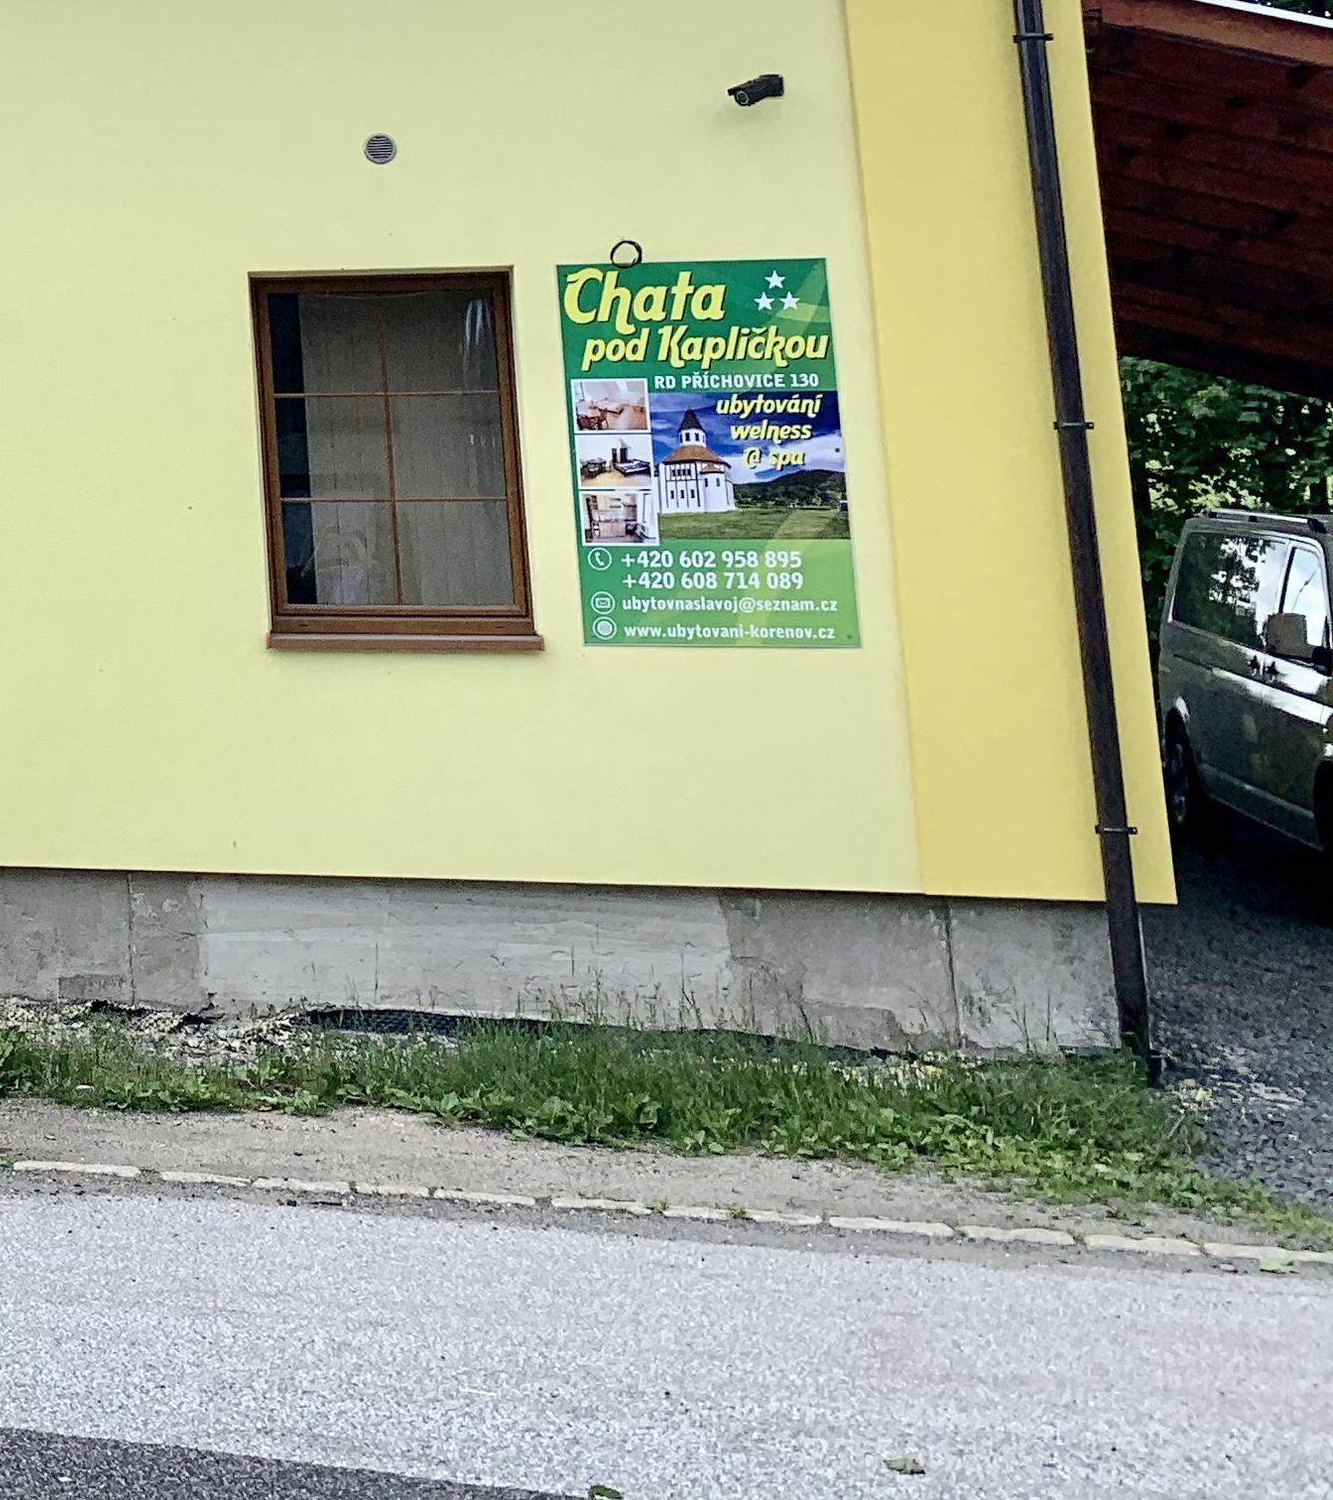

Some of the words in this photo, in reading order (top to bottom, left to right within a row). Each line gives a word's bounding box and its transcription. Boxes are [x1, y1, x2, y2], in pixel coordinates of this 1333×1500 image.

[563, 267, 726, 334] Chata
[581, 329, 648, 371] pod
[657, 325, 829, 369] Kapličkou
[654, 375, 676, 390] RD
[681, 372, 784, 389] PŘÍCHOVICE
[790, 373, 819, 388] 130
[715, 393, 822, 419] ubytování
[730, 423, 812, 447] welness
[768, 453, 805, 471] spa
[620, 551, 673, 569] +420
[679, 551, 716, 569] 602
[721, 551, 759, 569] 958
[764, 550, 802, 569] 895
[622, 573, 675, 590] +420
[680, 573, 718, 590] 608
[723, 572, 760, 590] 714
[766, 572, 804, 590] 089
[622, 596, 838, 613] ubytovnaslavoj@seznam.cz
[624, 623, 836, 640] www.ubytovani-korenov.cz
